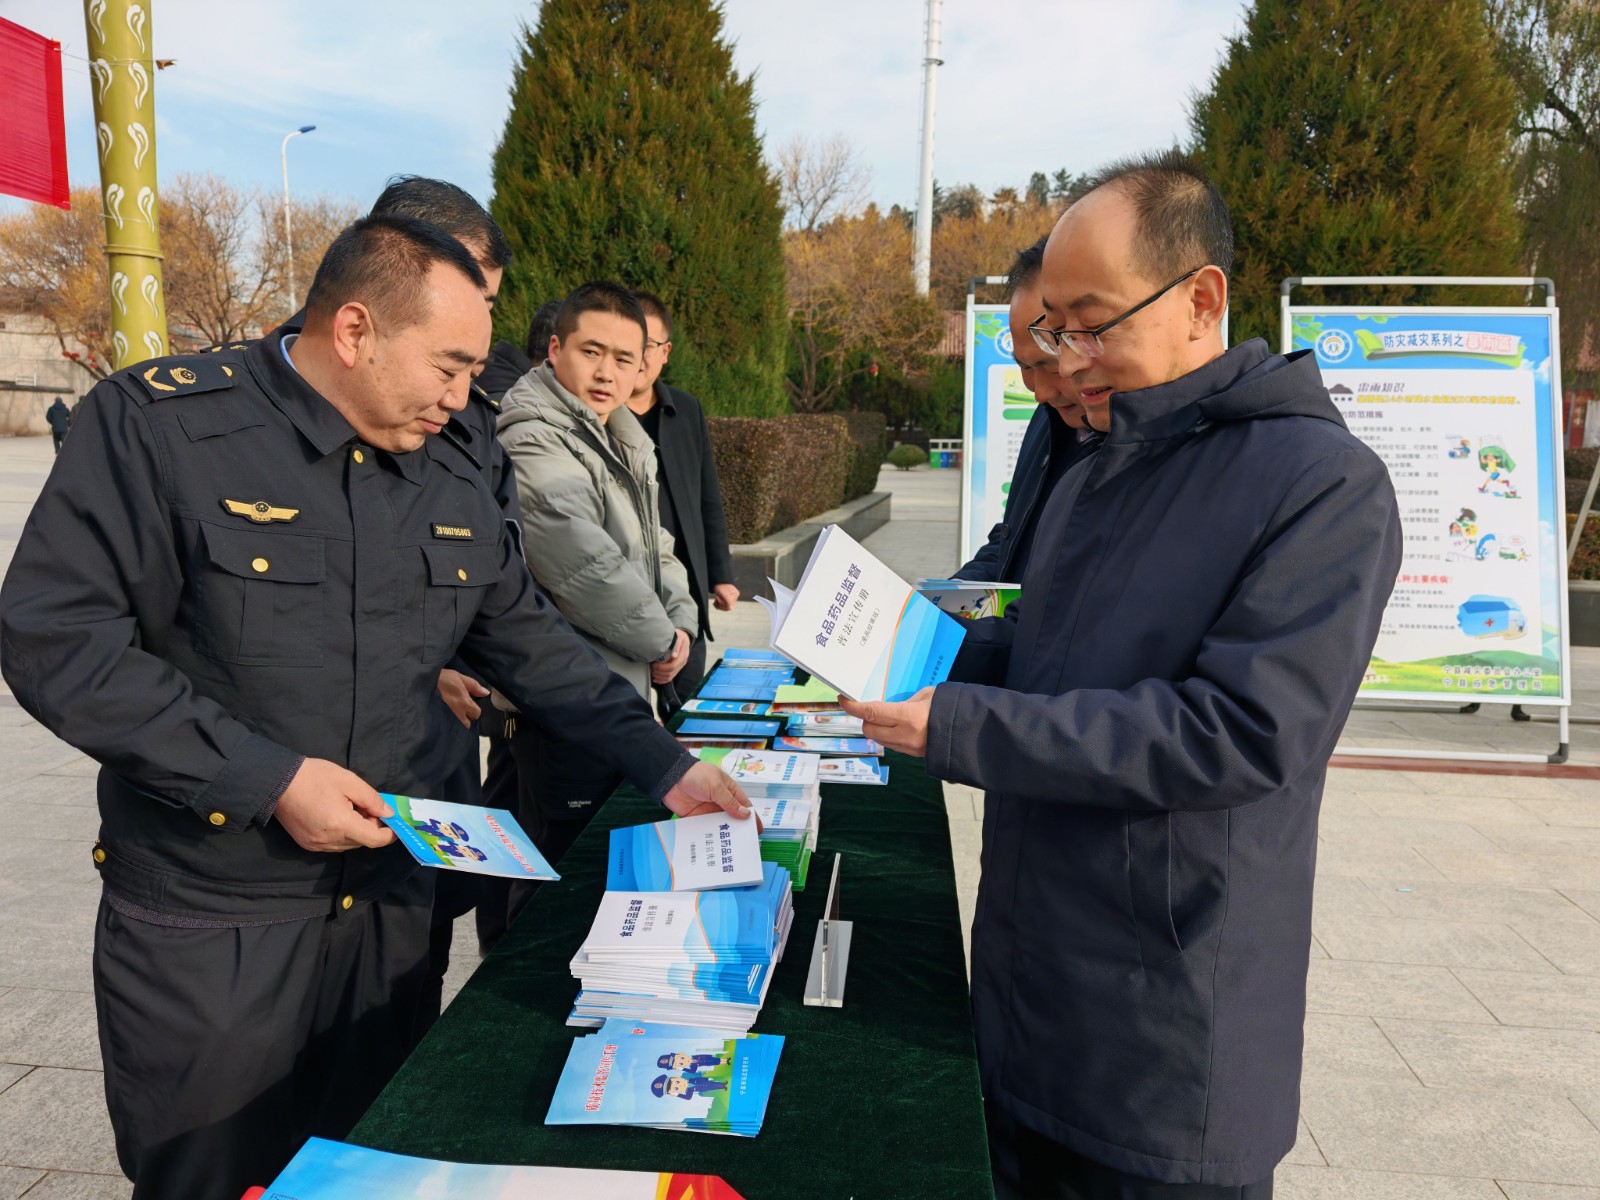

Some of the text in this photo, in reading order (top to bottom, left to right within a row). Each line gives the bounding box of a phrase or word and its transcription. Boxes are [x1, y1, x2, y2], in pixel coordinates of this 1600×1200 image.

[815, 563, 863, 648] 食品药品监督
[838, 588, 870, 647] 普法宣传册
[718, 823, 734, 873] 食品药品监督
[619, 899, 643, 937] 食品药品监督
[585, 1044, 619, 1112] 质量技术监督宣传手册
